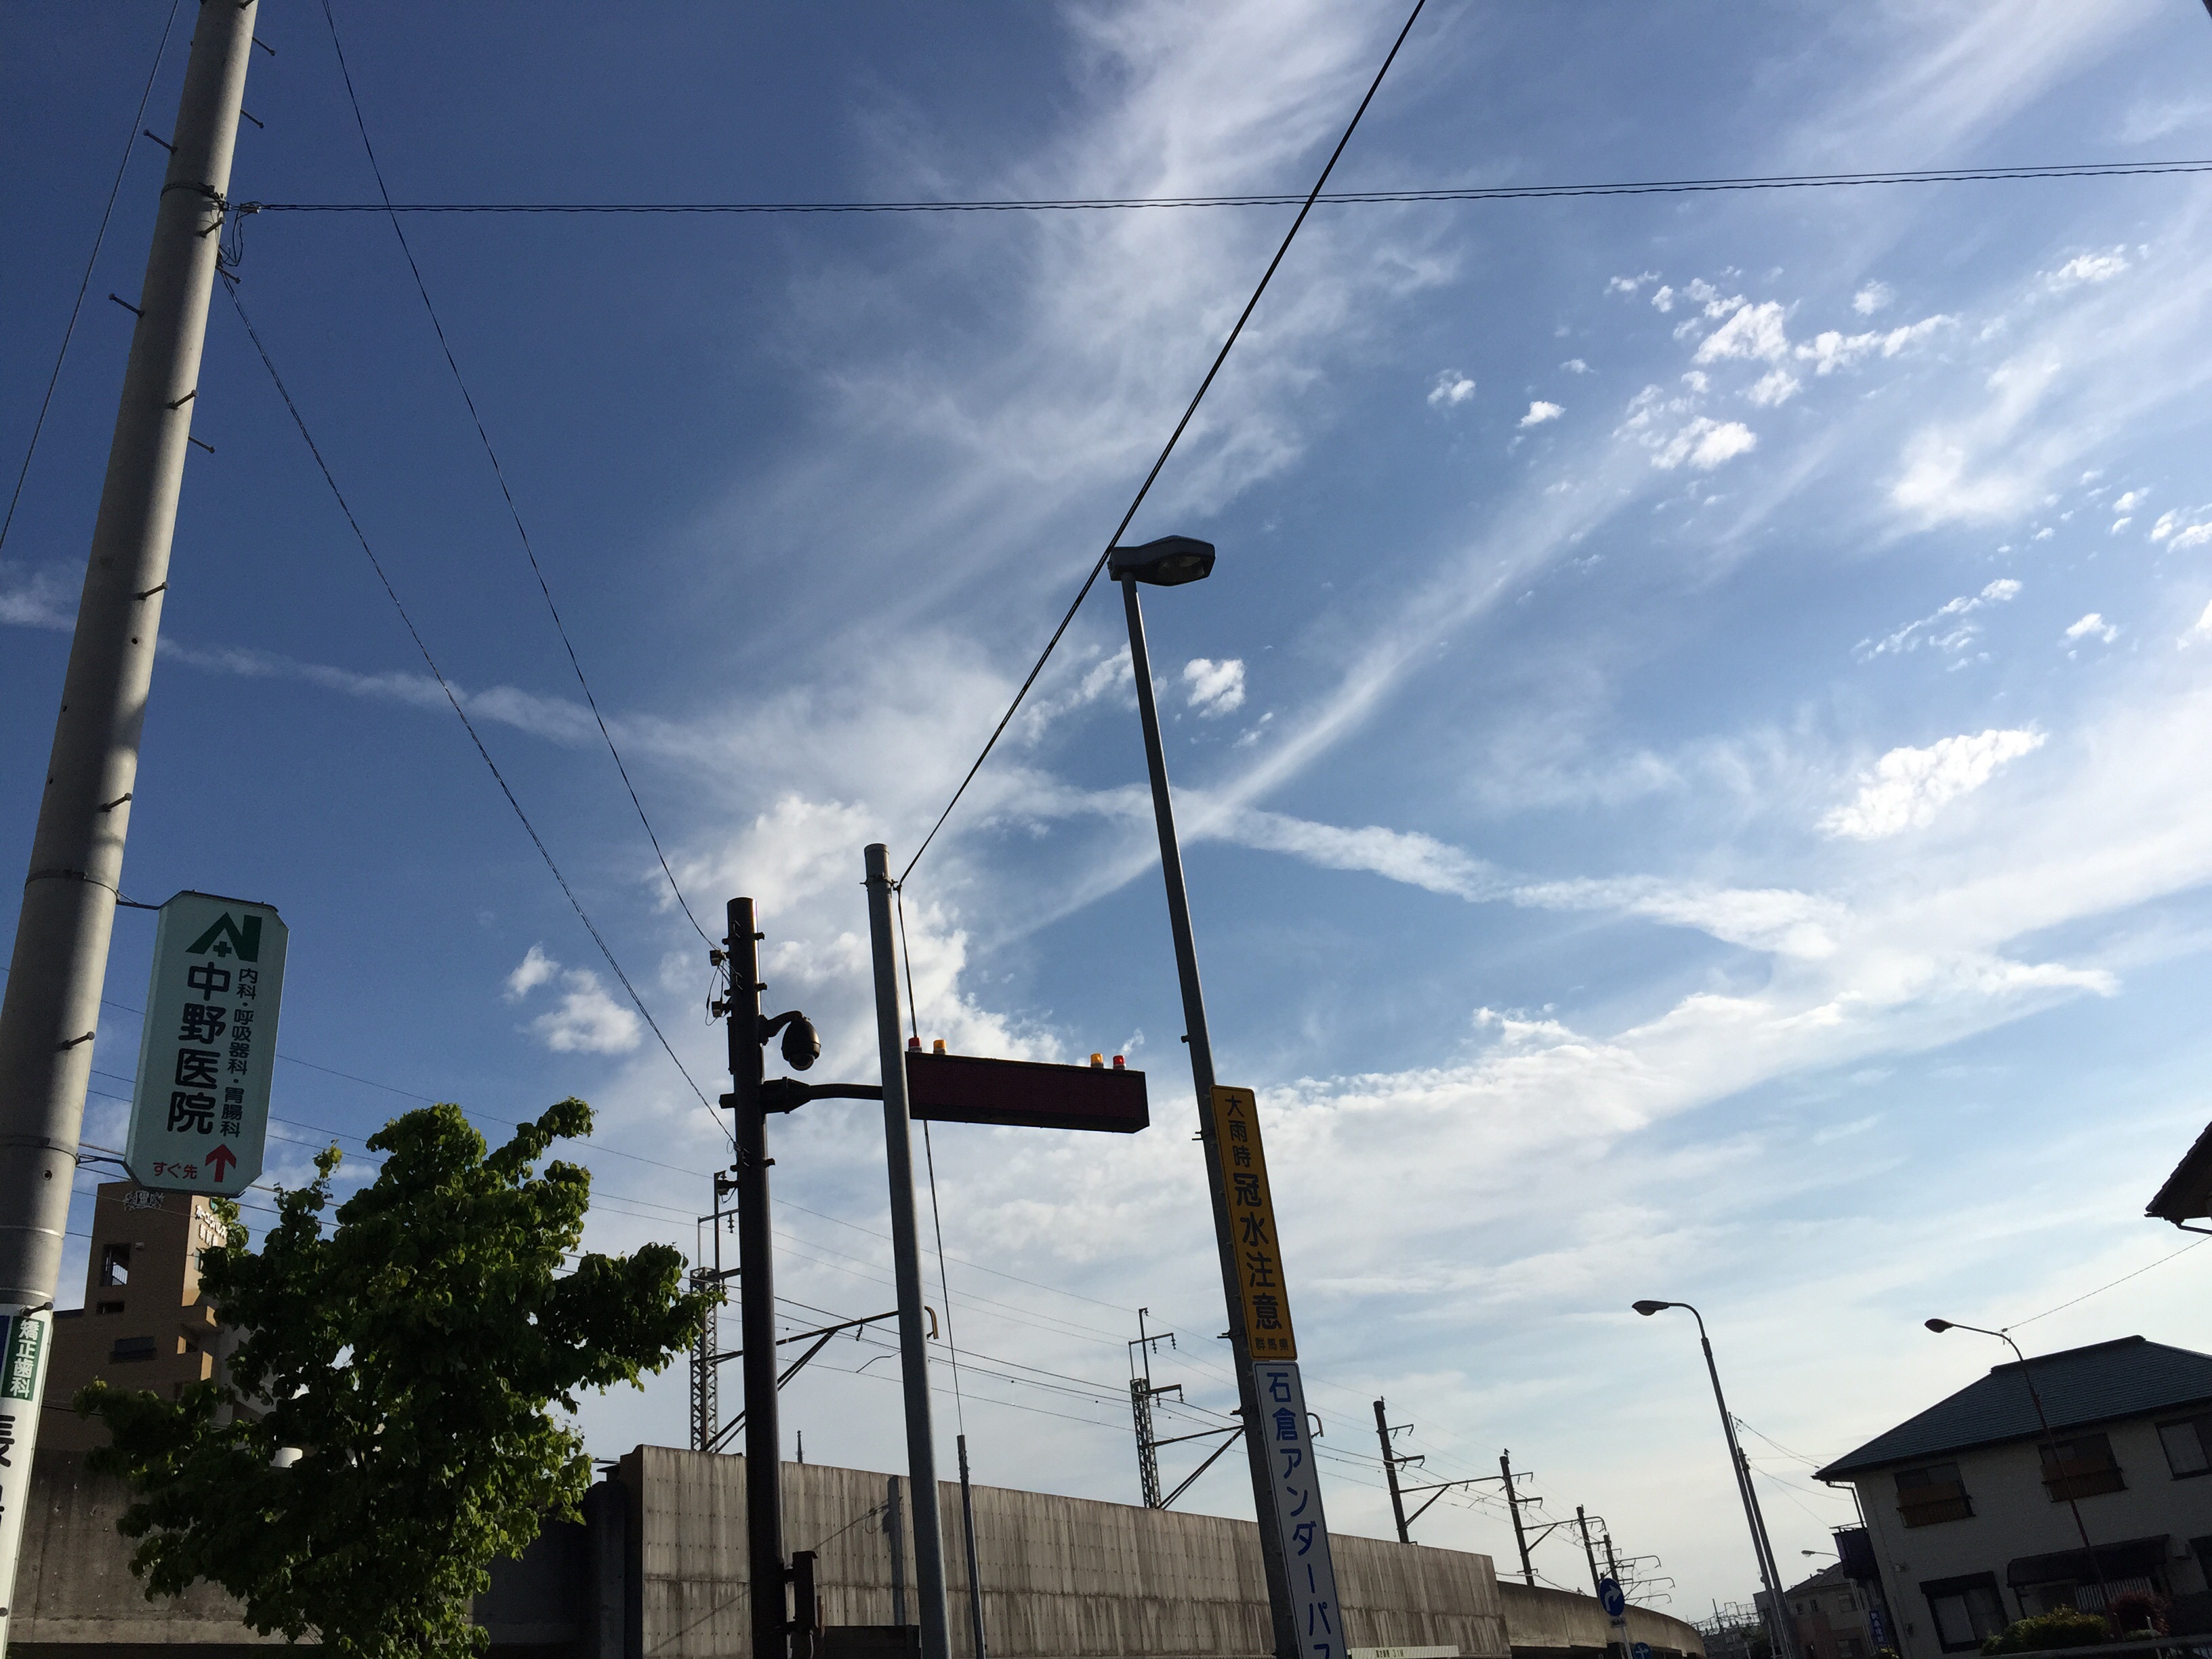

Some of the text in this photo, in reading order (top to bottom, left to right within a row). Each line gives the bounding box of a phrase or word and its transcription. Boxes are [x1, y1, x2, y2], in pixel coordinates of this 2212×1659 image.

[167, 961, 231, 1135] 中野医院
[152, 1162, 199, 1180] すぐ先
[9, 1319, 40, 1399] 矯正歯科
[1255, 1337, 1289, 1351] 群馬県
